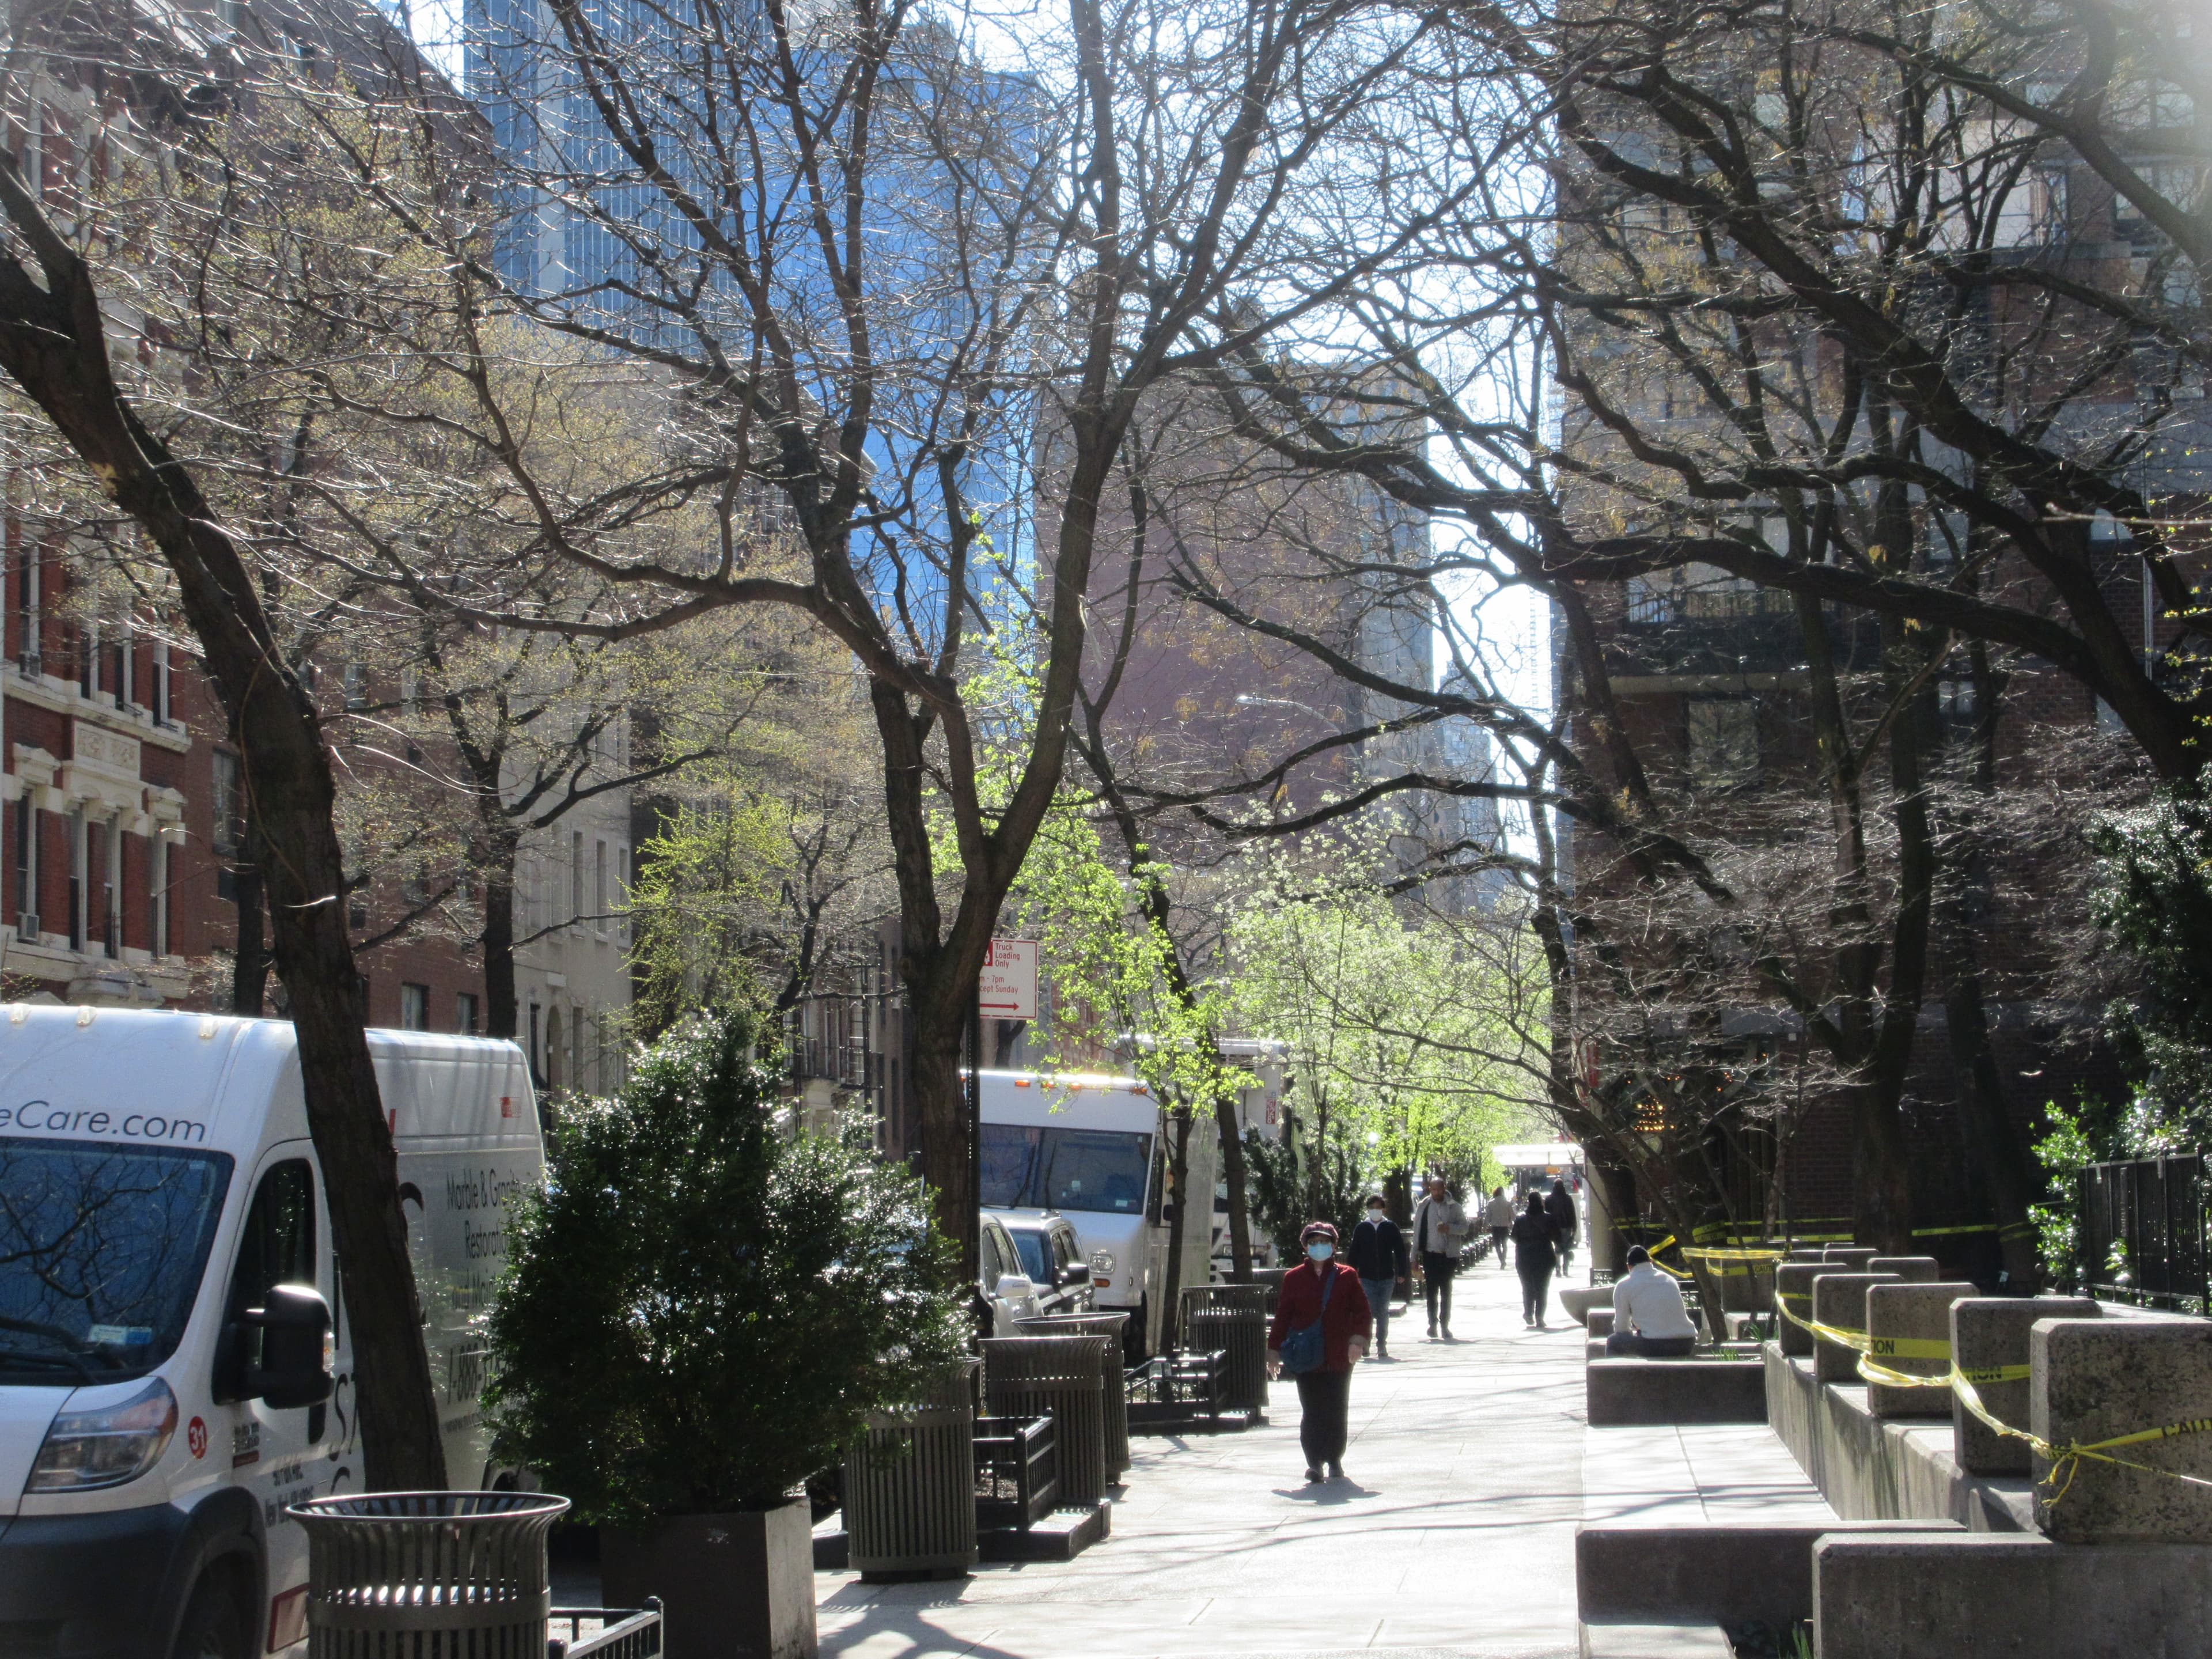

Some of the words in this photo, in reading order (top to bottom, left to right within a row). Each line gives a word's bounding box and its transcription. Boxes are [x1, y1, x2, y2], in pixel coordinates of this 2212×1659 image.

[995, 943, 1013, 951] Truck
[995, 952, 1020, 960] Loading
[995, 960, 1009, 969] Only
[992, 975, 1005, 983] 7pm
[995, 986, 1018, 995] Sunday
[0, 1100, 206, 1142] eCare.com
[447, 1168, 478, 1210] Marble
[480, 1171, 488, 1208] &
[465, 1220, 509, 1258] Restoratio
[190, 1426, 205, 1451] 31
